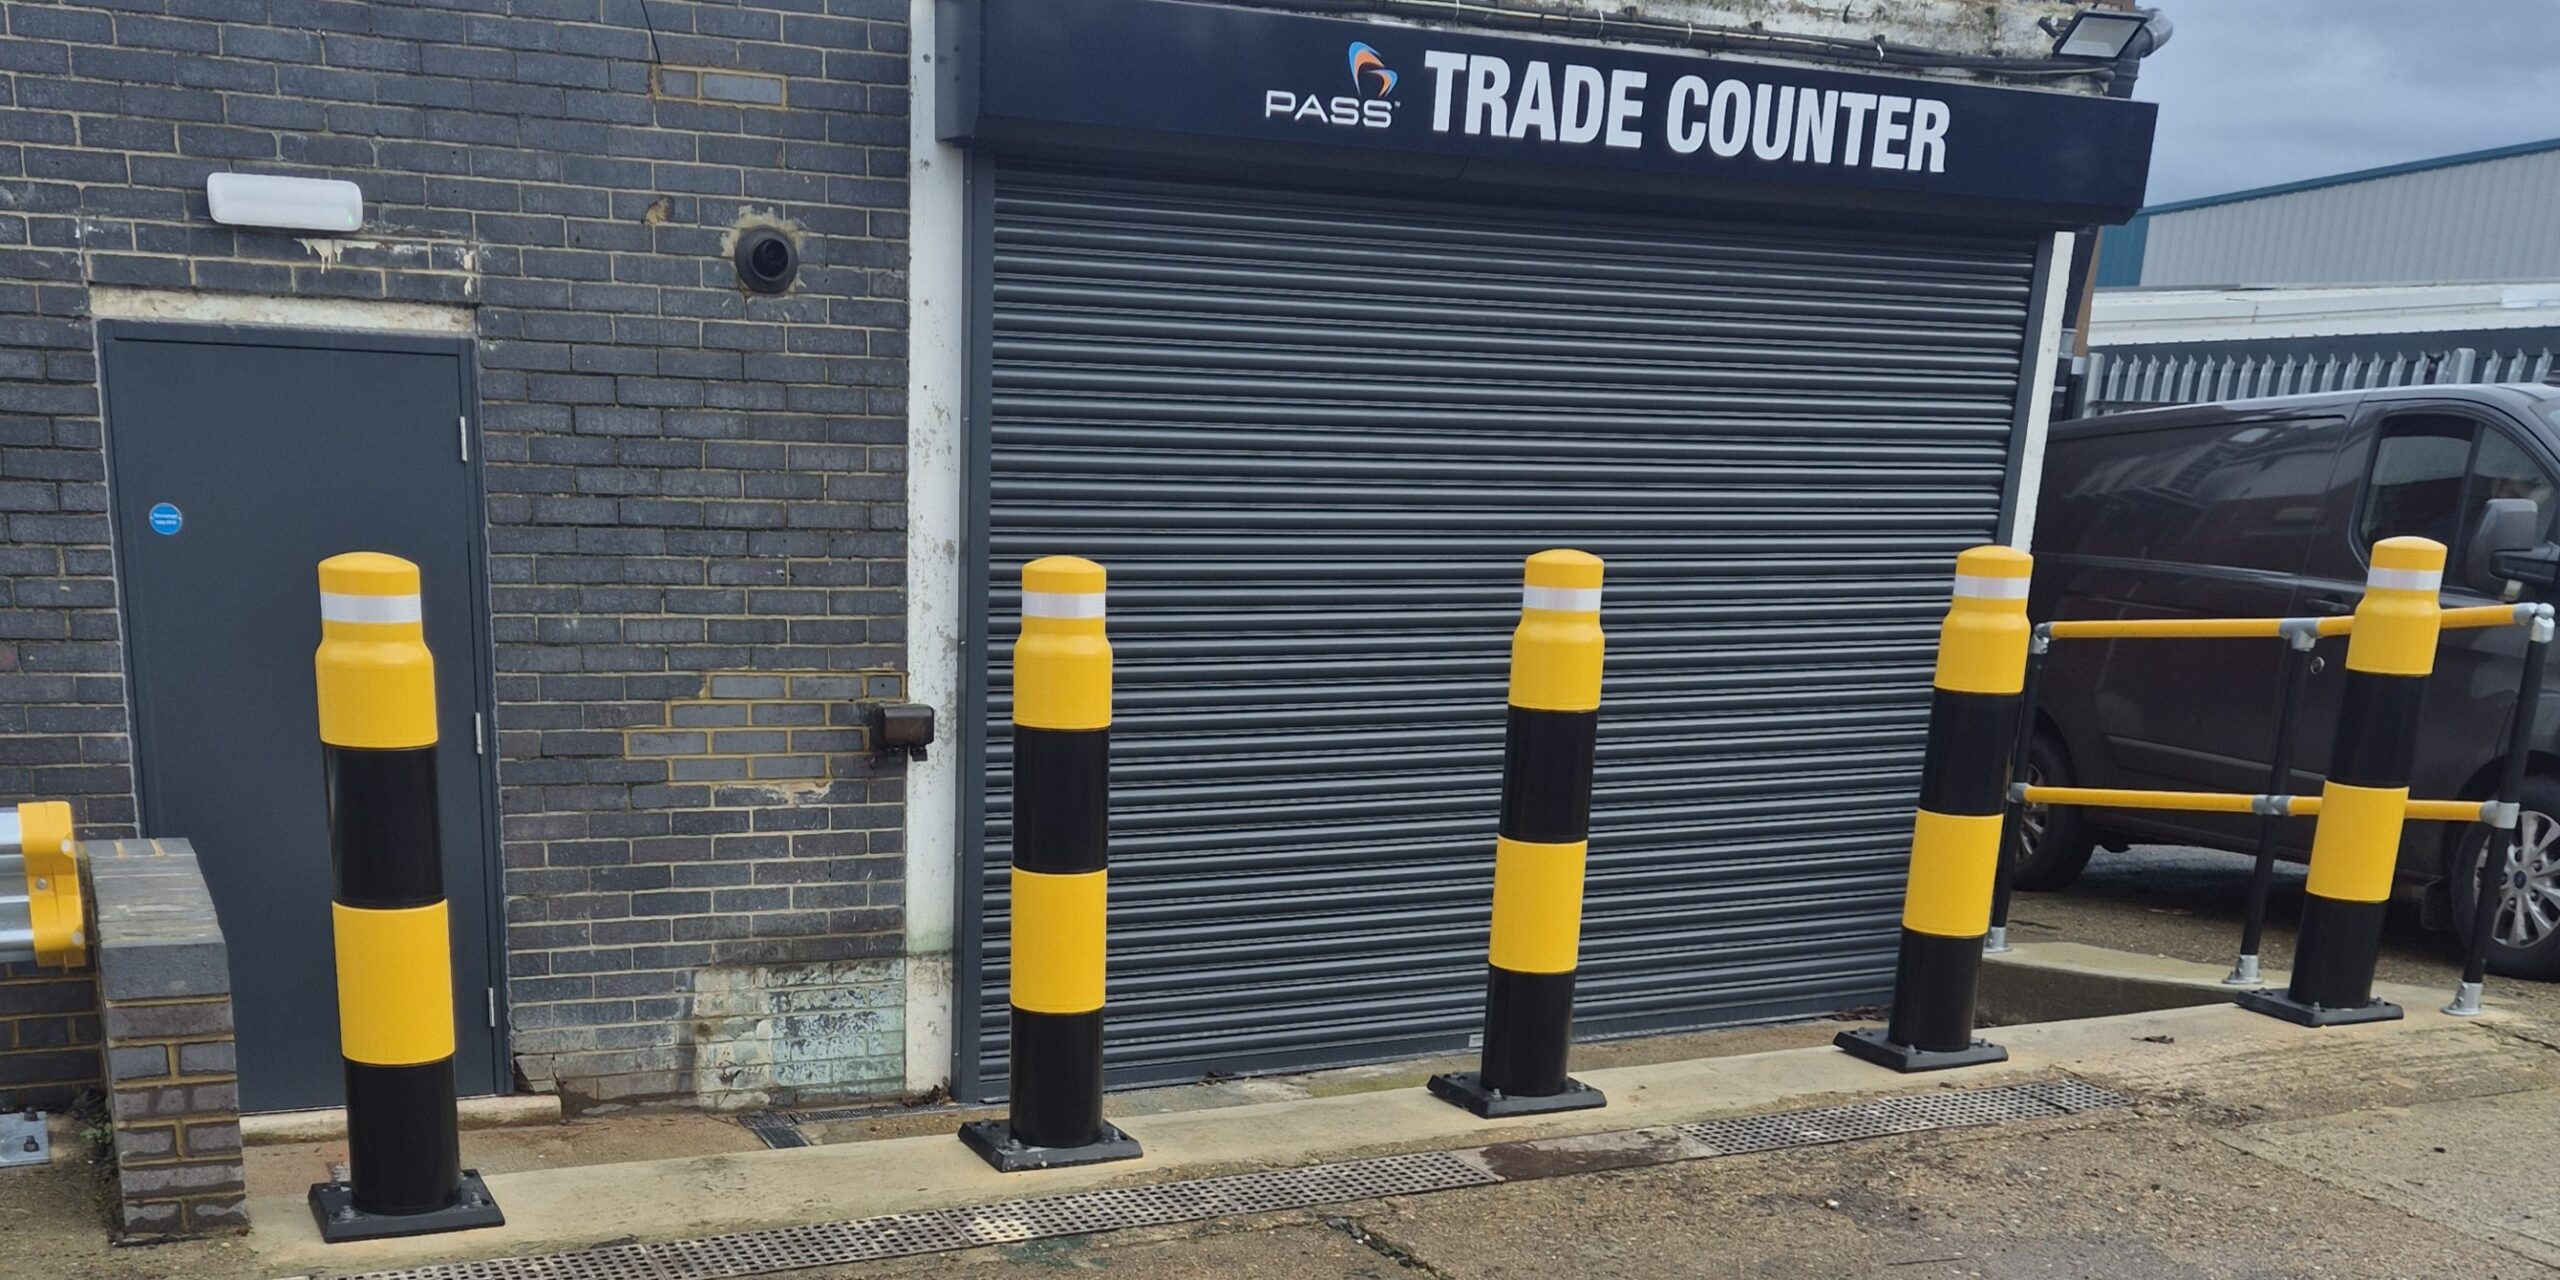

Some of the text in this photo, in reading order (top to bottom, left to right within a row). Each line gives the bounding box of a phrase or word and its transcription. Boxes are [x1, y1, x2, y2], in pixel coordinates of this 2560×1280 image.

[1265, 89, 1393, 129] PASS
[1424, 50, 1951, 173] TRADE COUNTER
